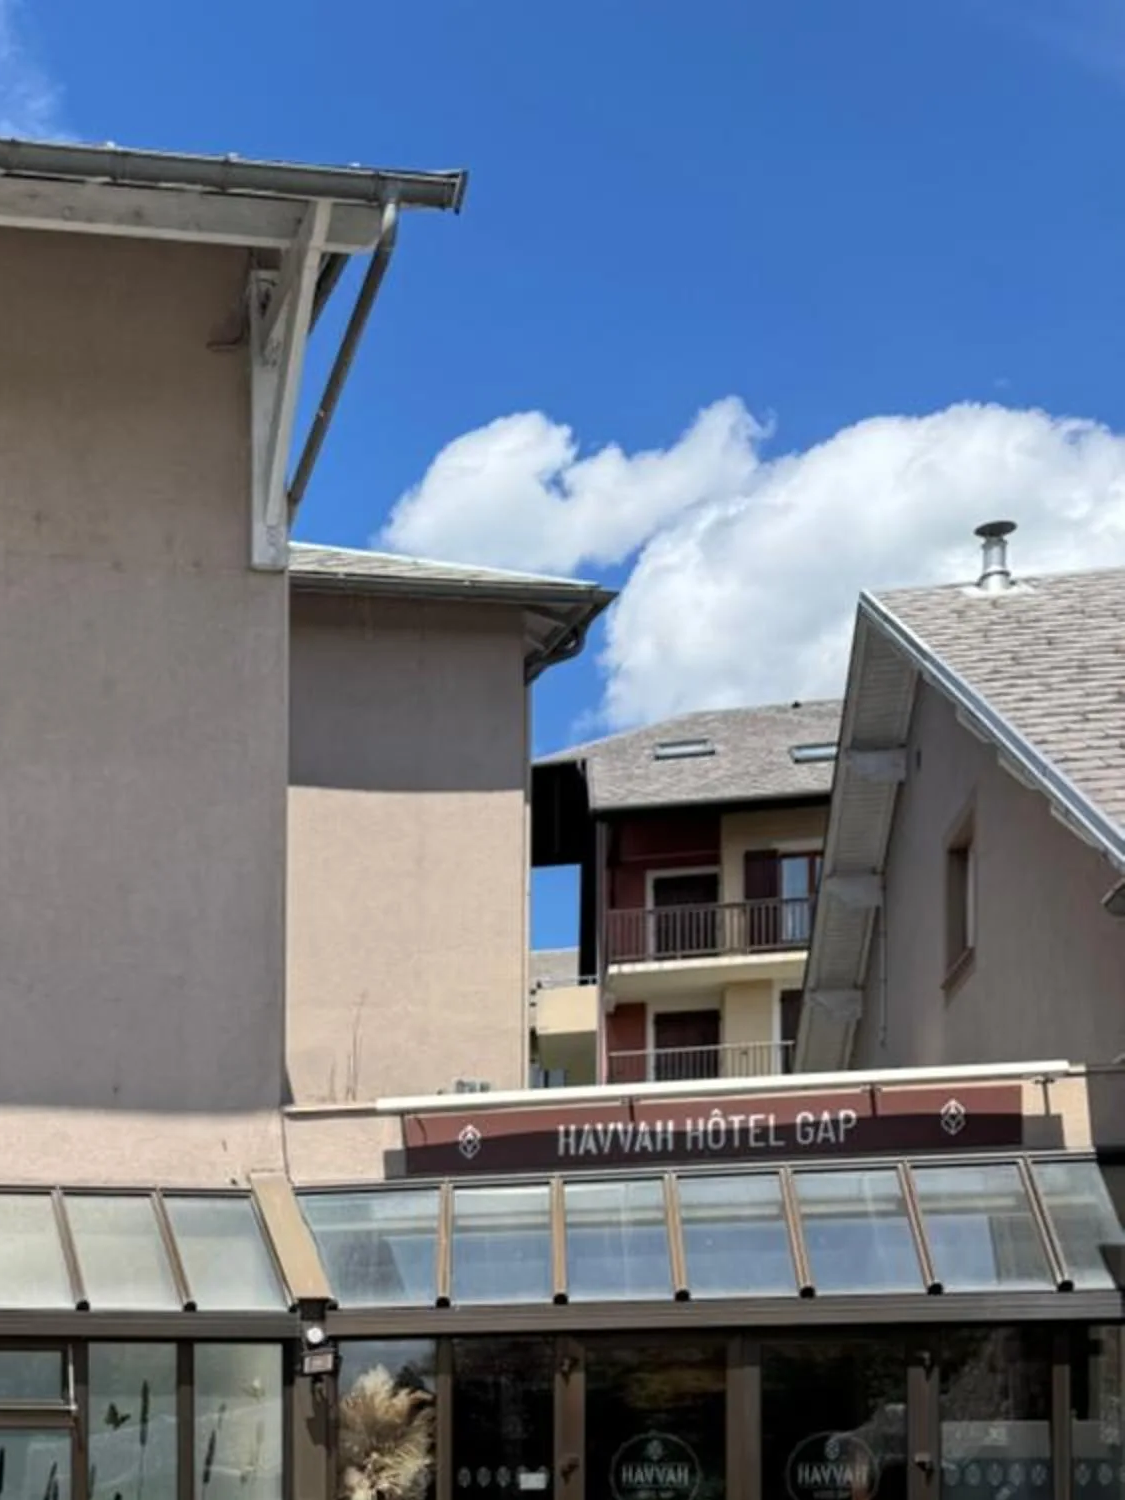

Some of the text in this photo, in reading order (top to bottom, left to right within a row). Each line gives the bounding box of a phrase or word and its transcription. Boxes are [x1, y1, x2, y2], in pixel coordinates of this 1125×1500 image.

[557, 1108, 858, 1156] HAVVAH HÔTEL GAP
[621, 1463, 690, 1486] HAVVAH
[797, 1462, 869, 1486] HAVVAH
